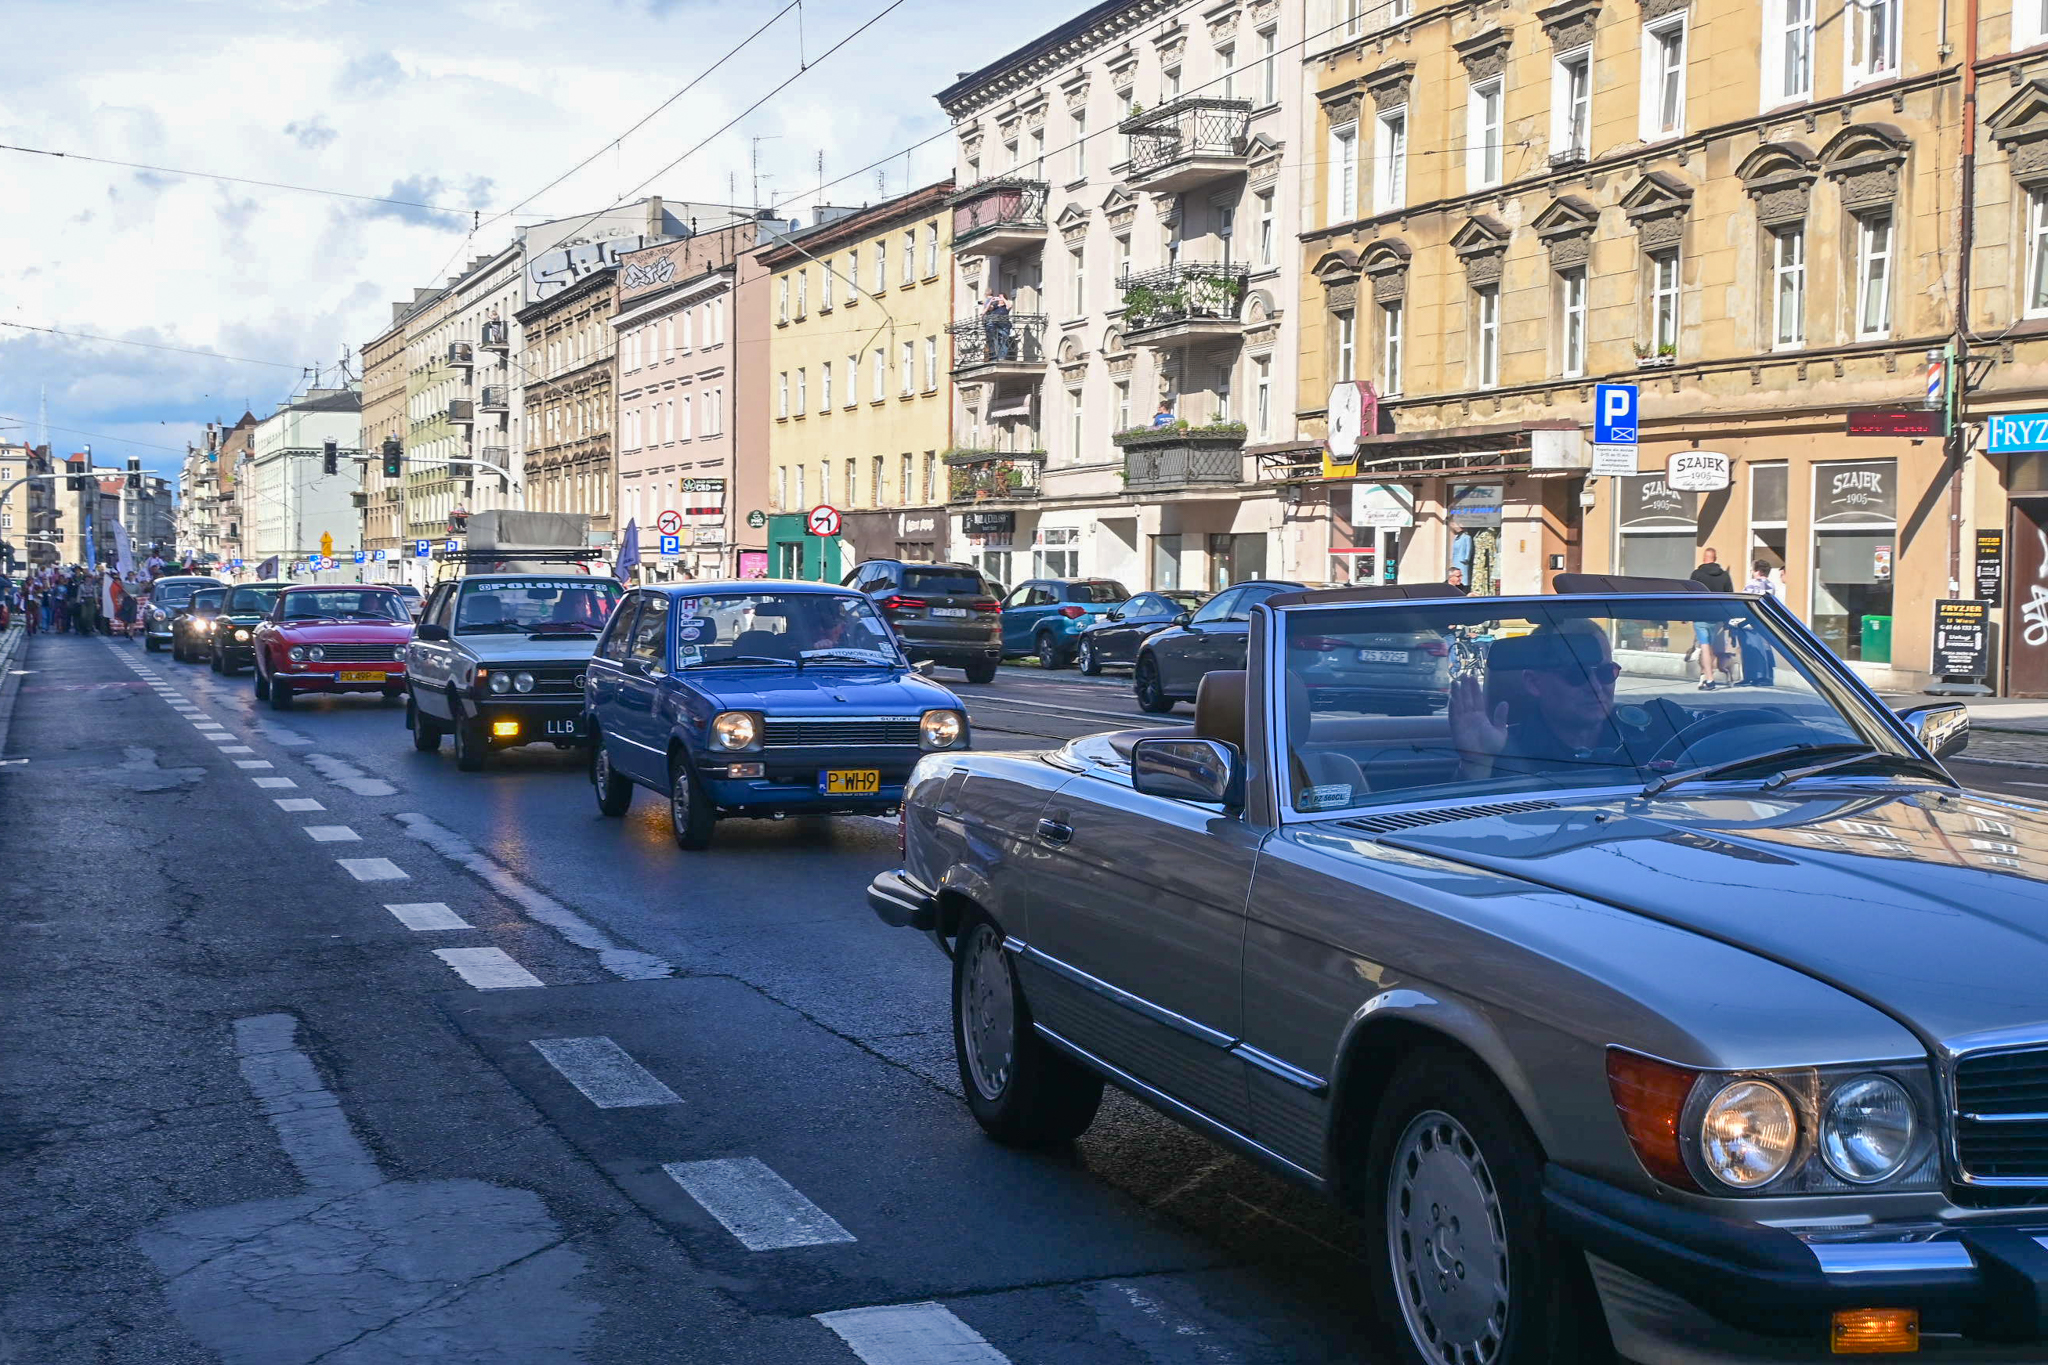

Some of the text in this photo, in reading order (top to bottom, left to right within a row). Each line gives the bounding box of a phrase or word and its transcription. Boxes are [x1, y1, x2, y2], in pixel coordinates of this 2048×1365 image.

[1604, 389, 1630, 427] P
[1990, 416, 2048, 448] FRYZ
[1677, 457, 1725, 472] SZAJEK
[1691, 471, 1711, 481] 1905
[1832, 471, 1882, 494] SZAJEK
[1653, 499, 1670, 510] 1905
[1846, 493, 1867, 505] 1905
[418, 540, 428, 552] P
[663, 537, 676, 553] P
[492, 582, 596, 591] POLONEZ
[1941, 604, 1983, 612] FRYZJER
[547, 719, 575, 734] LLB
[845, 772, 876, 790] WH9
